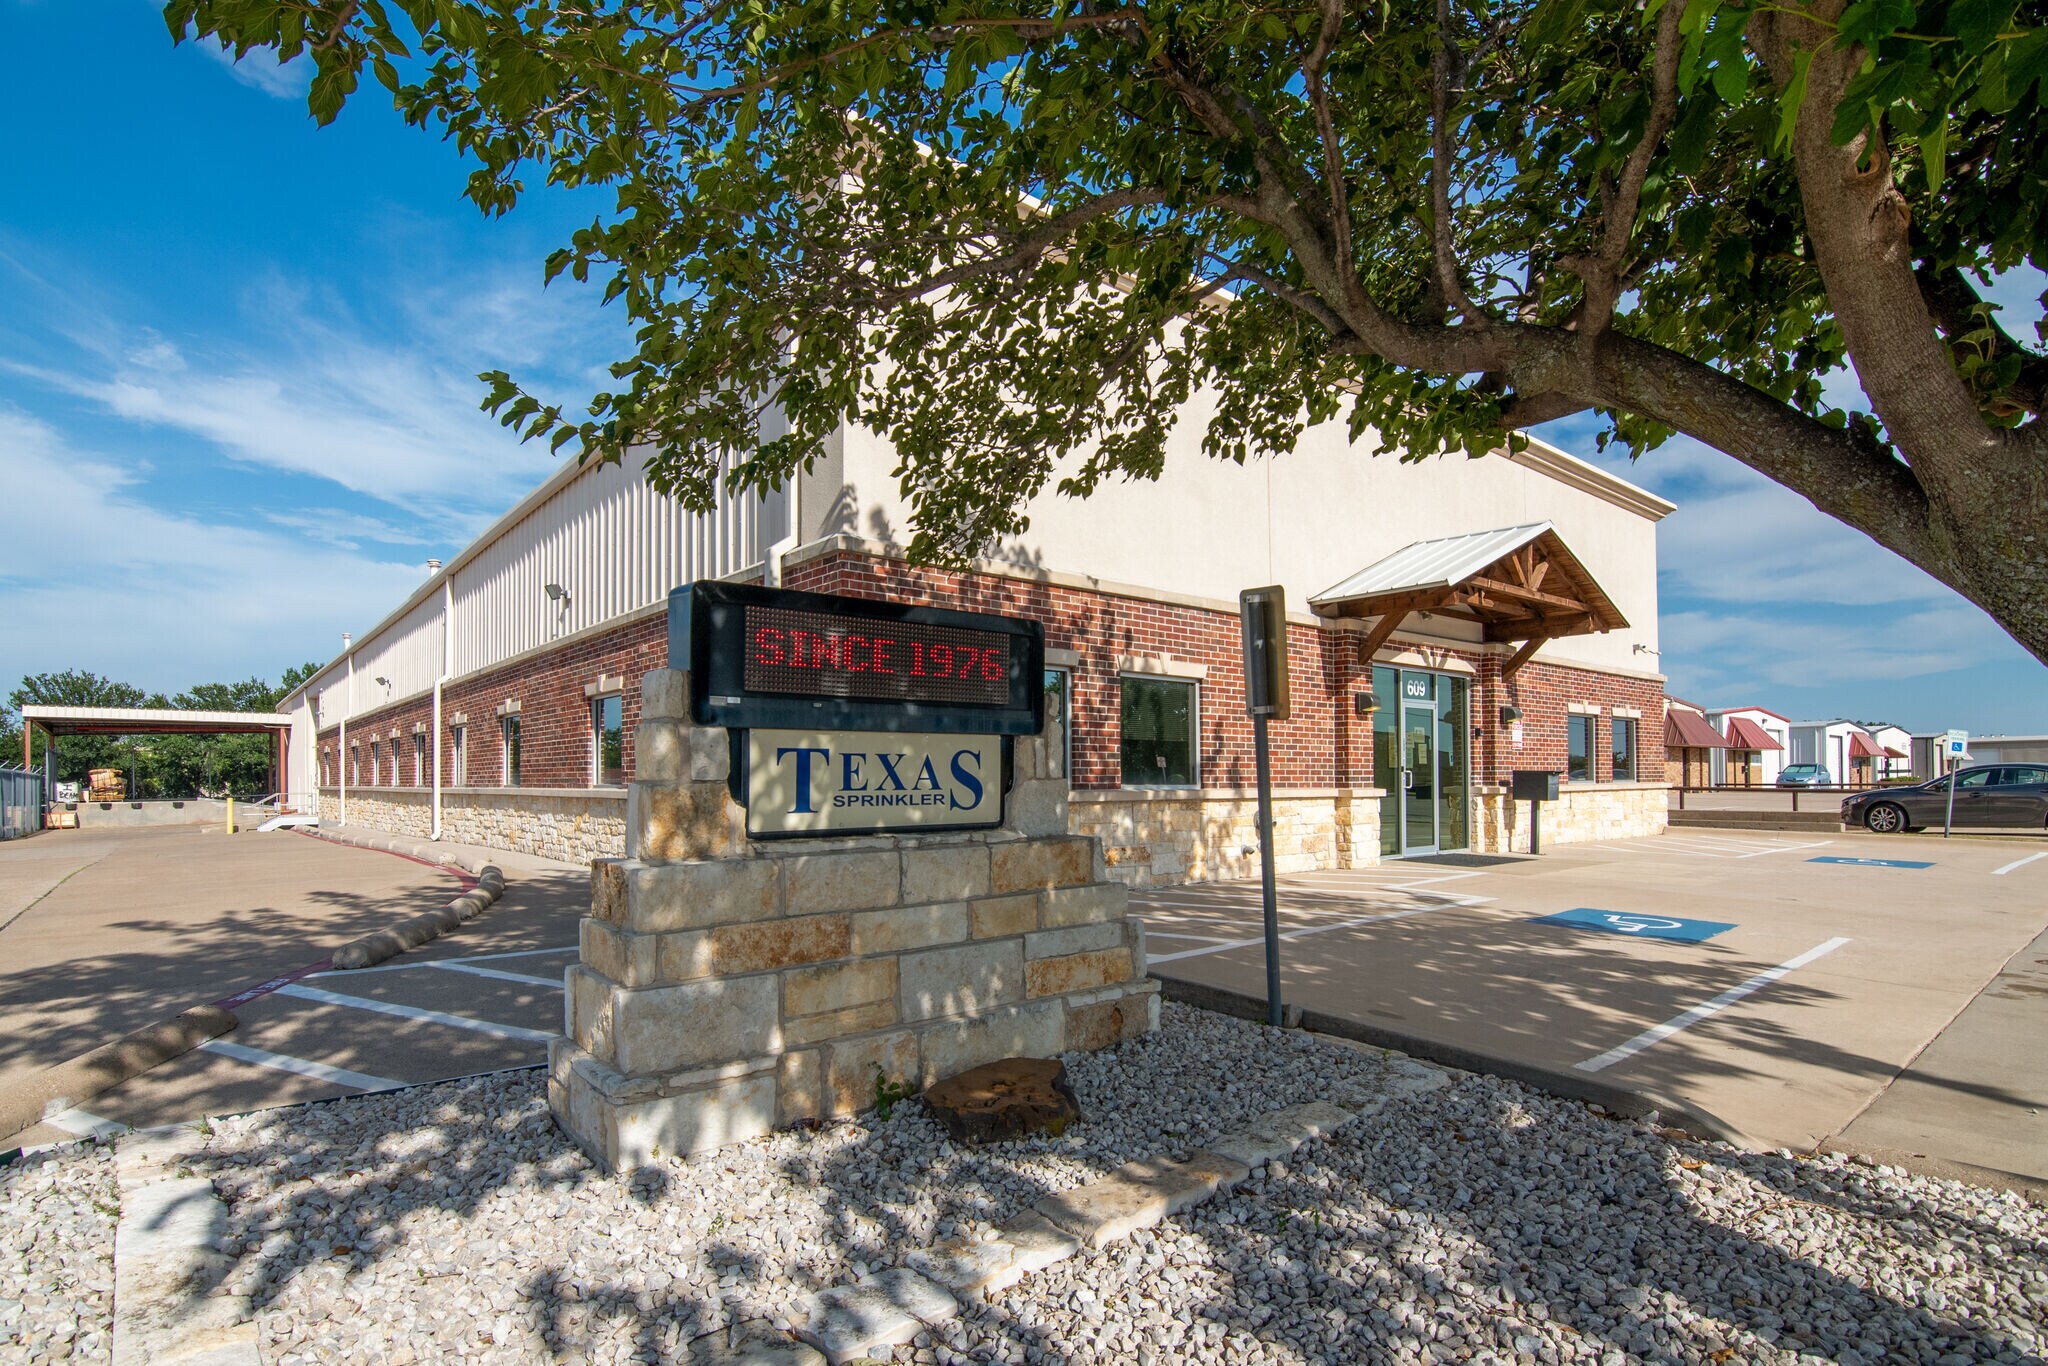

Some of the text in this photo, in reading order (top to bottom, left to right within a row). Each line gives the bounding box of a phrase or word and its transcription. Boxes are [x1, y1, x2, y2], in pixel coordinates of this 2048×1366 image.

[755, 627, 1004, 682] SINCE 1976
[1407, 680, 1426, 697] 609
[776, 747, 984, 814] TEXAS
[832, 792, 946, 808] SPRINKLER
